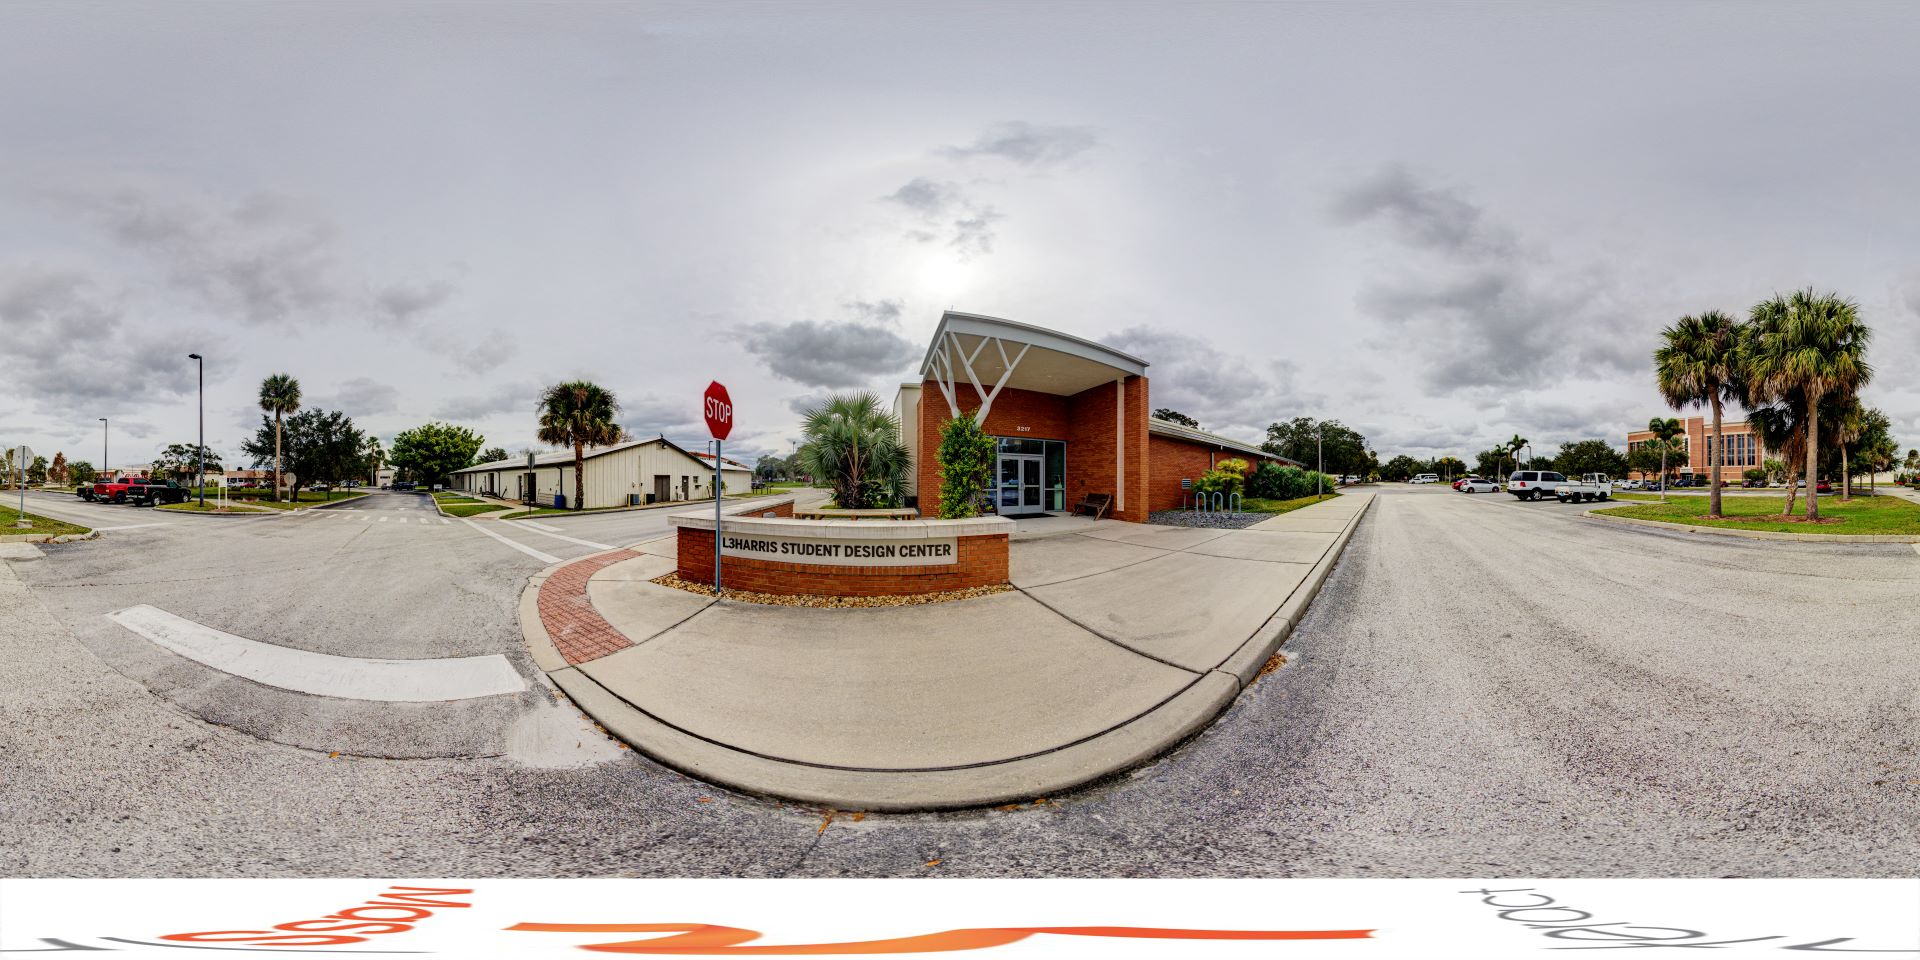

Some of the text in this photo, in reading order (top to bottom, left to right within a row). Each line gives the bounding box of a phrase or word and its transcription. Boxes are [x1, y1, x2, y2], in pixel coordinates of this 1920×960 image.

[706, 396, 731, 424] STOP
[722, 537, 951, 558] L3HARRIS STUDENT DESIGN CENTER
